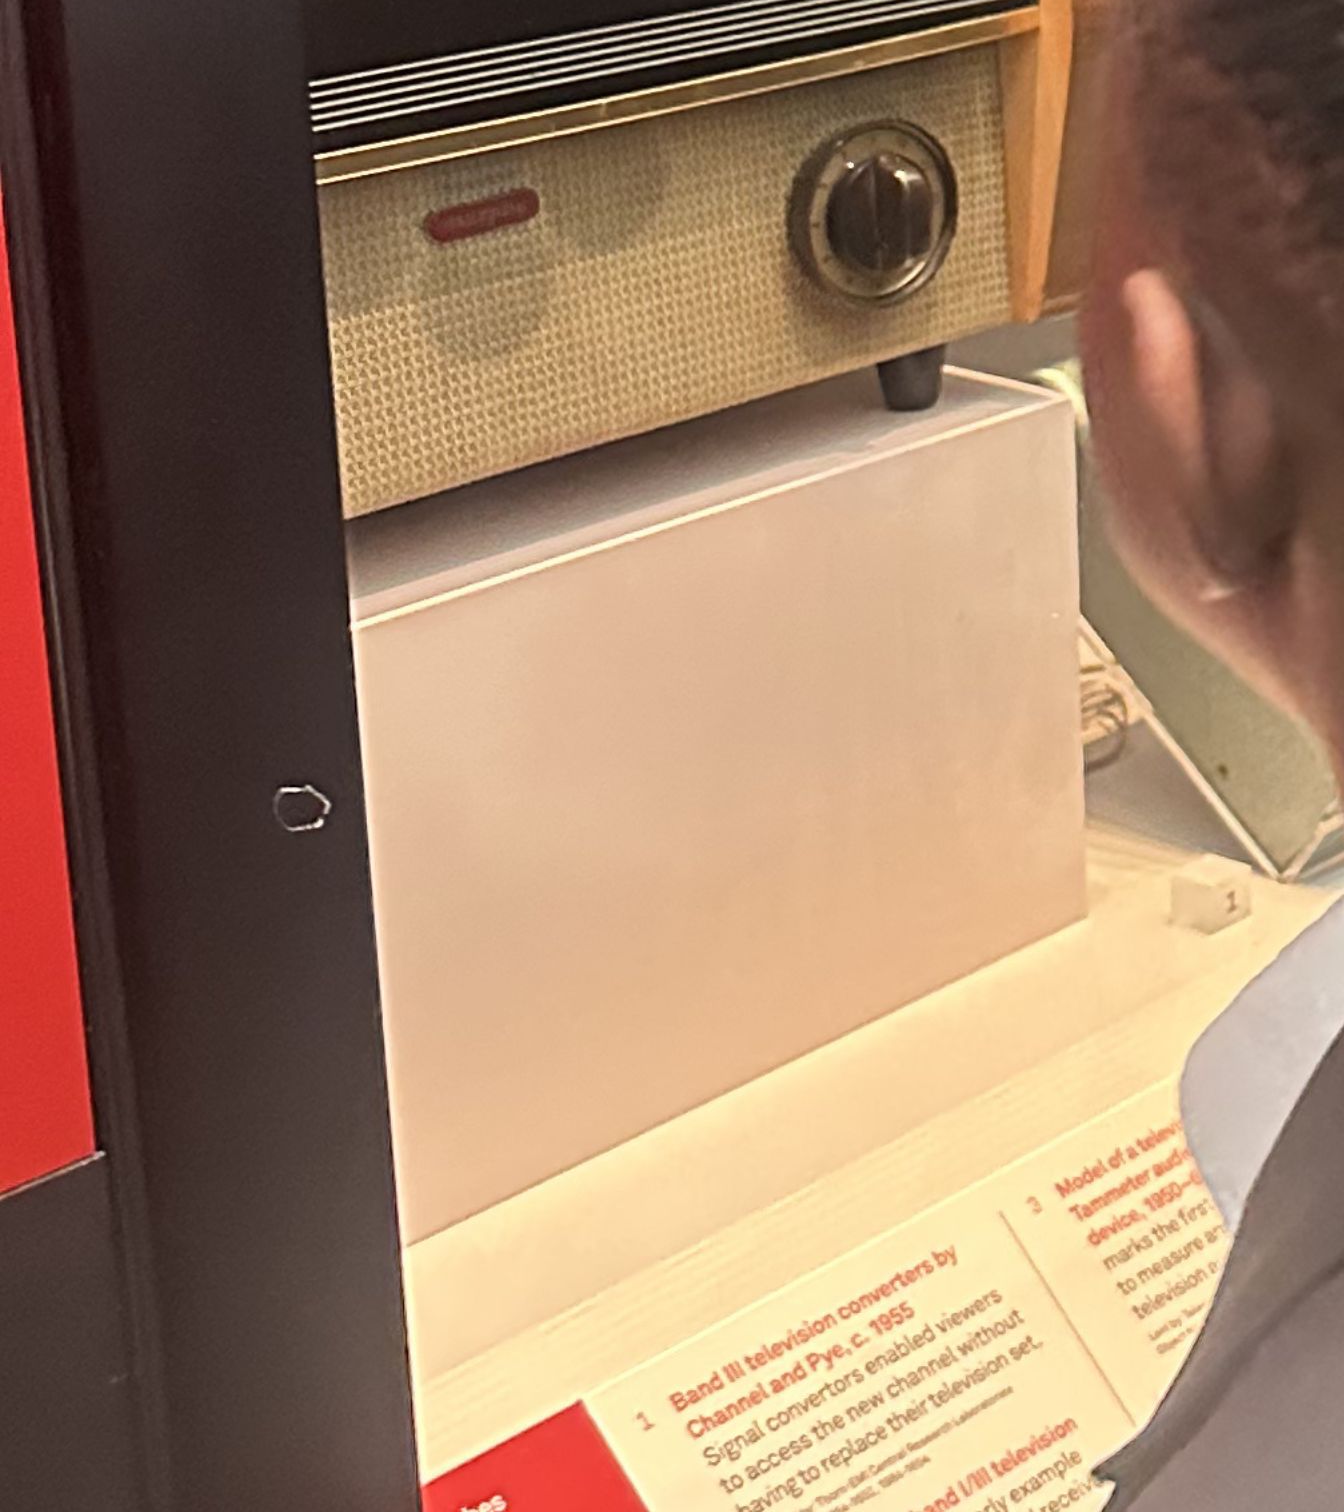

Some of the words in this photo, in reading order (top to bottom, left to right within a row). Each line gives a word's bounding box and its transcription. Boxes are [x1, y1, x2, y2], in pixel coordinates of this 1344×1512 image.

[1226, 890, 1239, 913] 1
[1054, 1158, 1109, 1199] Model
[1107, 1147, 1127, 1169] of
[1125, 1145, 1140, 1160] a
[1069, 1169, 1151, 1222] Tammeter
[1087, 1209, 1147, 1247] device,
[1103, 1235, 1155, 1271] marks
[1151, 1218, 1181, 1243] the
[1116, 1277, 1138, 1295] to
[1136, 1237, 1204, 1284] measure
[1132, 1265, 1208, 1319] television
[669, 1371, 724, 1412] Band
[721, 1360, 746, 1383] III
[744, 1320, 838, 1371] television
[838, 1259, 934, 1320] converters
[931, 1245, 958, 1267] by
[686, 1382, 770, 1439] Channel
[769, 1361, 807, 1395] and
[806, 1344, 853, 1371] Pye,
[850, 1333, 870, 1349] c.
[868, 1301, 915, 1335] 1955
[702, 1420, 766, 1467] Signal
[765, 1368, 865, 1432] convertors
[865, 1323, 936, 1375] enabled
[935, 1289, 1003, 1333] viewers
[636, 1411, 655, 1431] 1
[719, 1473, 744, 1494] to
[744, 1434, 813, 1481] access
[811, 1414, 846, 1441] the
[846, 1391, 886, 1422] new
[886, 1345, 960, 1399] channel
[957, 1309, 1025, 1356] without
[796, 1465, 821, 1484] to
[820, 1424, 888, 1473] replace
[886, 1399, 929, 1433] their
[928, 1354, 1011, 1408] television
[990, 1417, 1079, 1478] television
[1009, 1450, 1082, 1504] example
